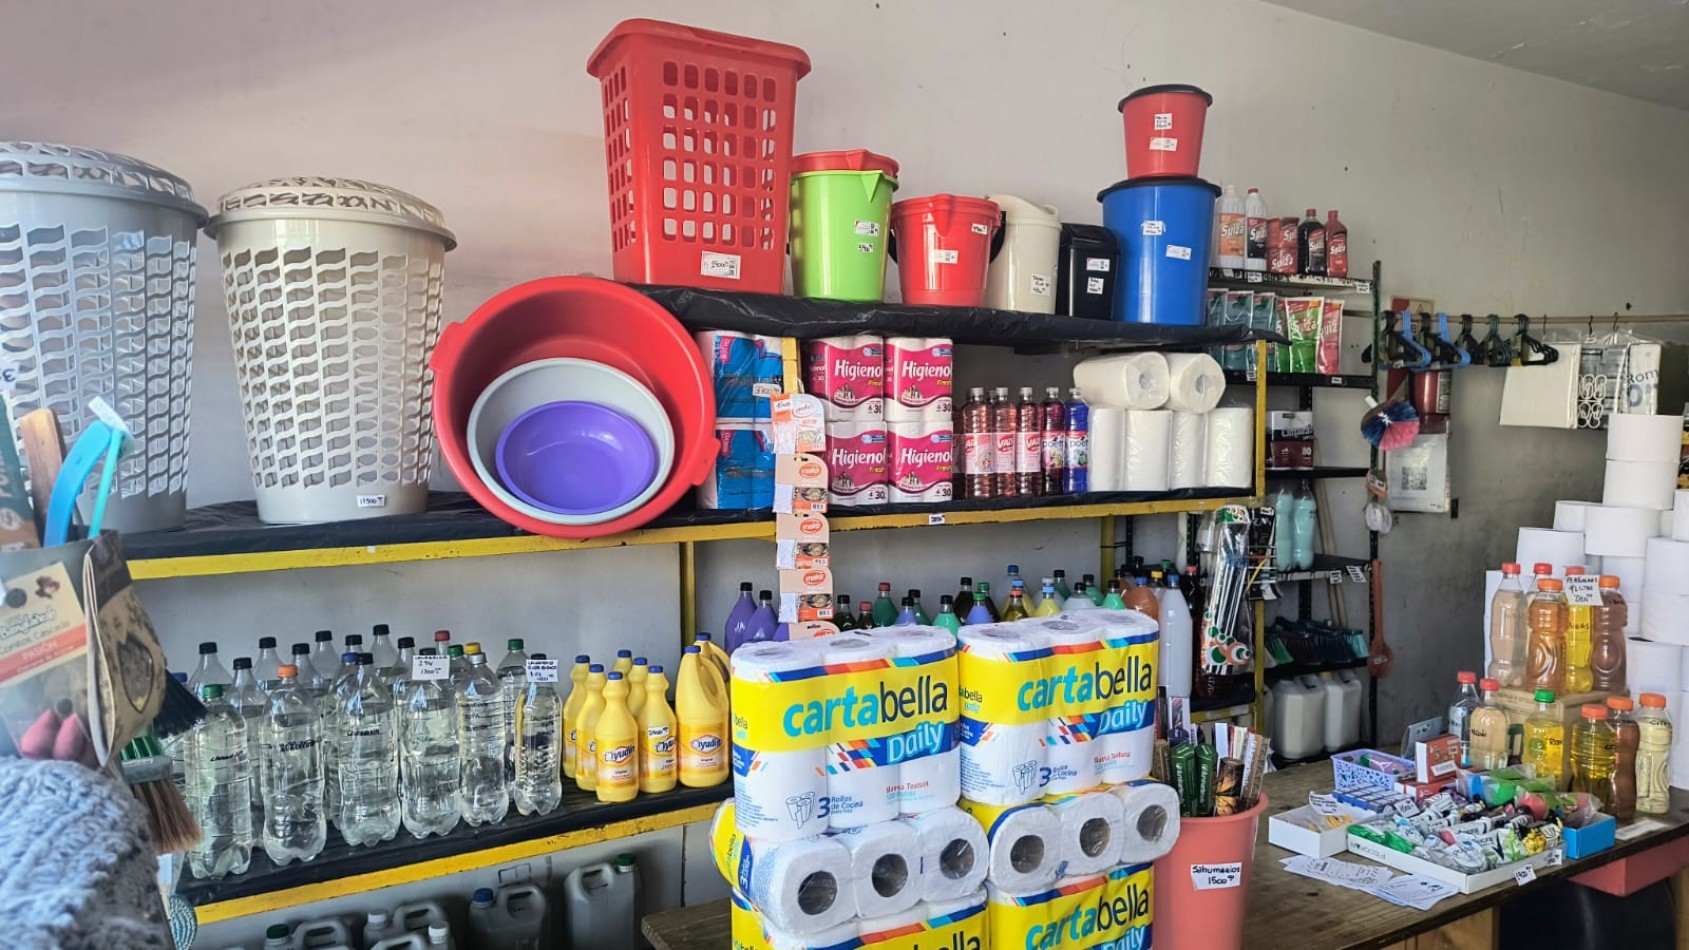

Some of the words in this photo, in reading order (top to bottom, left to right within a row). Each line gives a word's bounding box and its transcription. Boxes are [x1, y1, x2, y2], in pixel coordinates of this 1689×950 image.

[832, 448, 886, 469] Higienol
[875, 489, 886, 500] 30
[1017, 656, 1152, 711] cartabella
[783, 675, 948, 738] cartabella
[1098, 699, 1147, 735] Daily
[886, 721, 945, 764] Daily
[1039, 767, 1052, 787] 3
[817, 796, 831, 819] 3
[831, 795, 852, 803] Rollos
[841, 801, 863, 810] Cocina
[1026, 884, 1149, 950] cartabella
